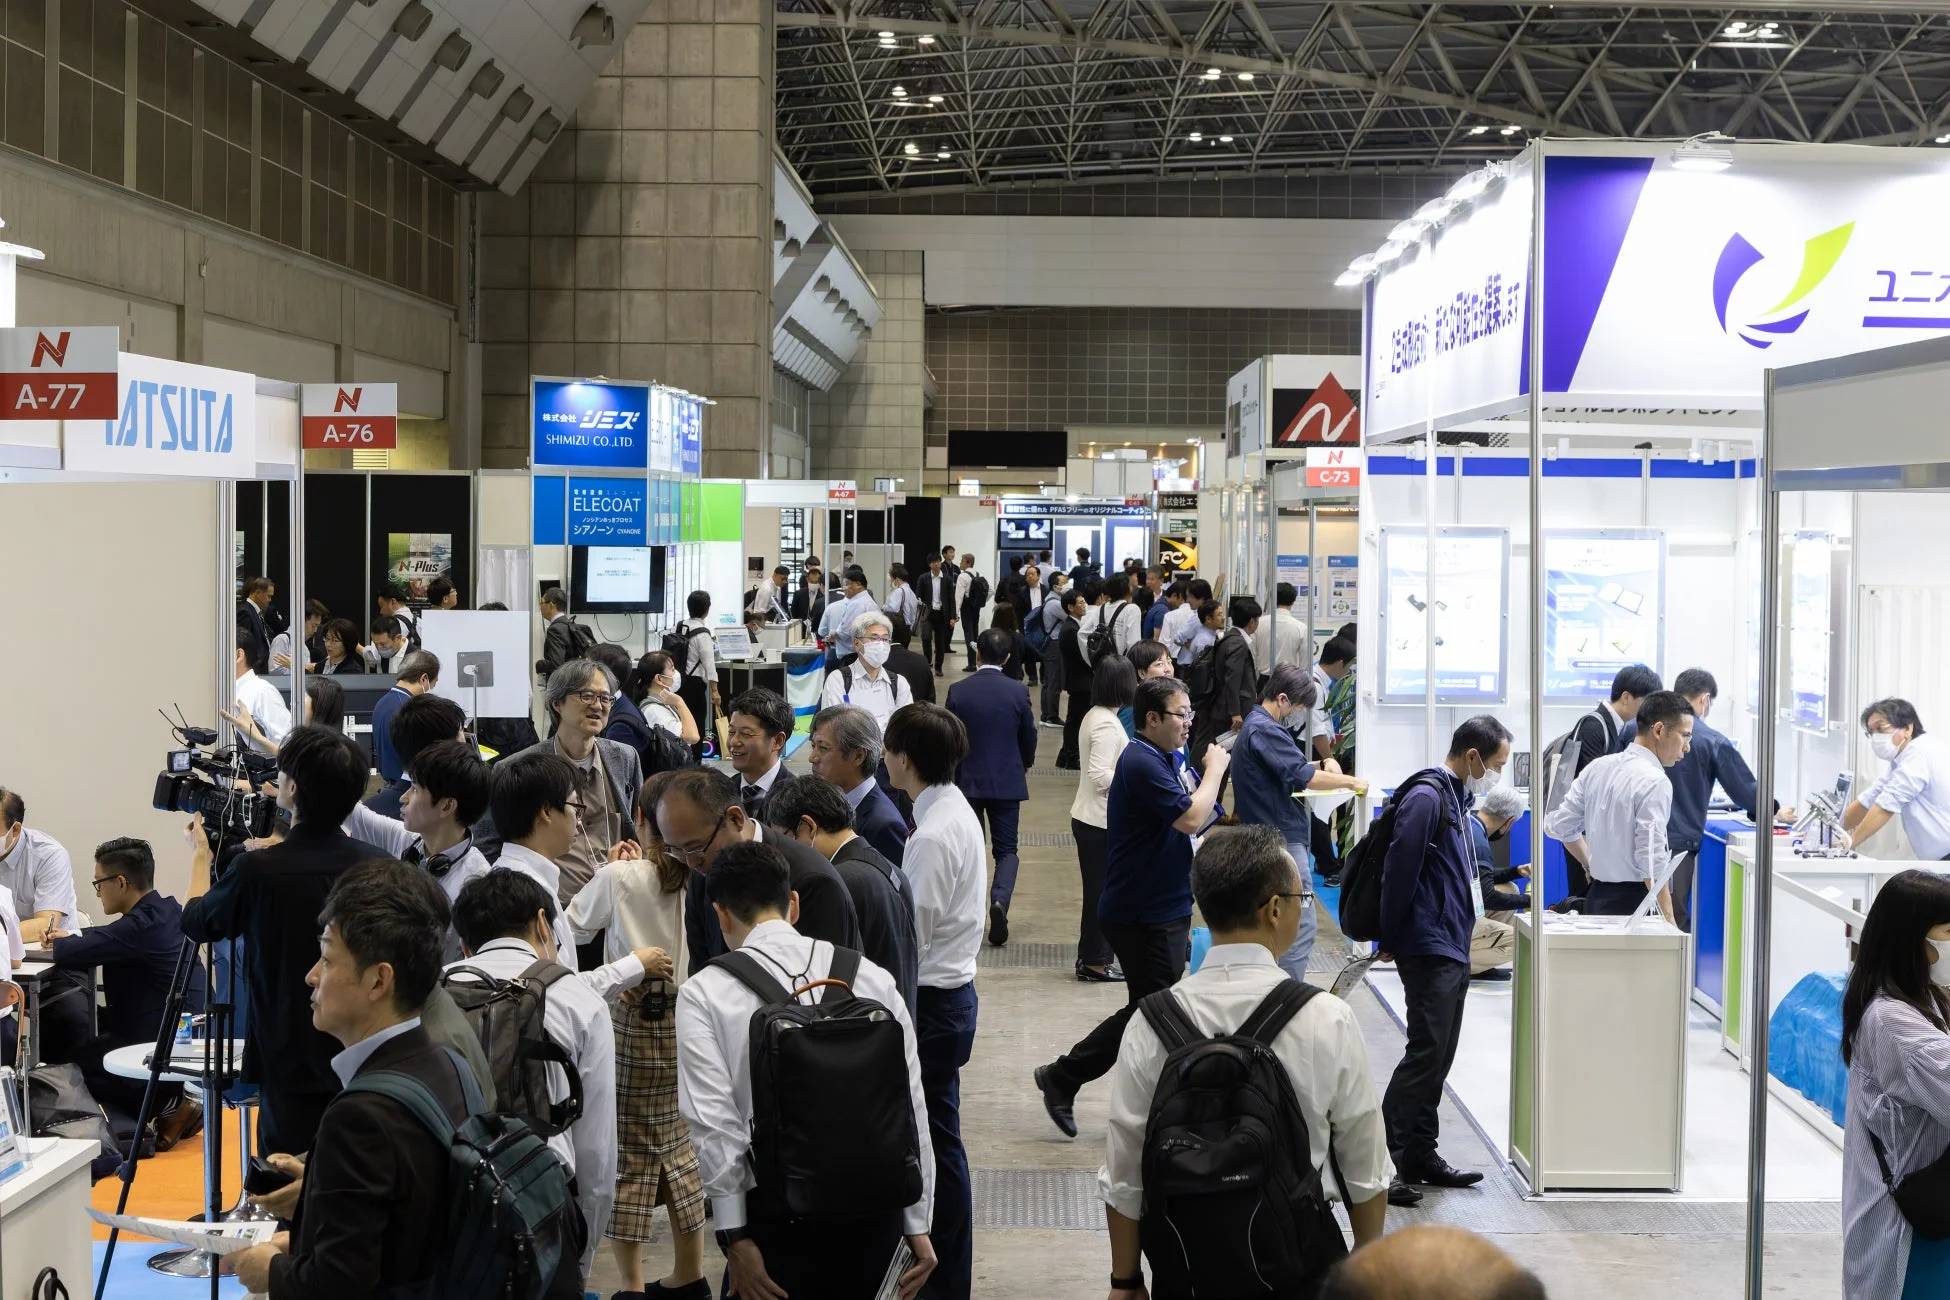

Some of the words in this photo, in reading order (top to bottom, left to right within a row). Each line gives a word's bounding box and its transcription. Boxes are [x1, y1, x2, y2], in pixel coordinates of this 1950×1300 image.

[15, 384, 86, 410] A-77
[542, 412, 577, 424] 株式会社
[579, 409, 641, 430] シミズ
[322, 424, 374, 443] A-76
[546, 434, 590, 446] SHIMIZU
[593, 436, 635, 448] CO.,LTD.
[1319, 471, 1350, 483] C-73
[573, 497, 642, 512] ELECOAT
[573, 525, 614, 535] シアノーン
[399, 560, 440, 573] N-Plus
